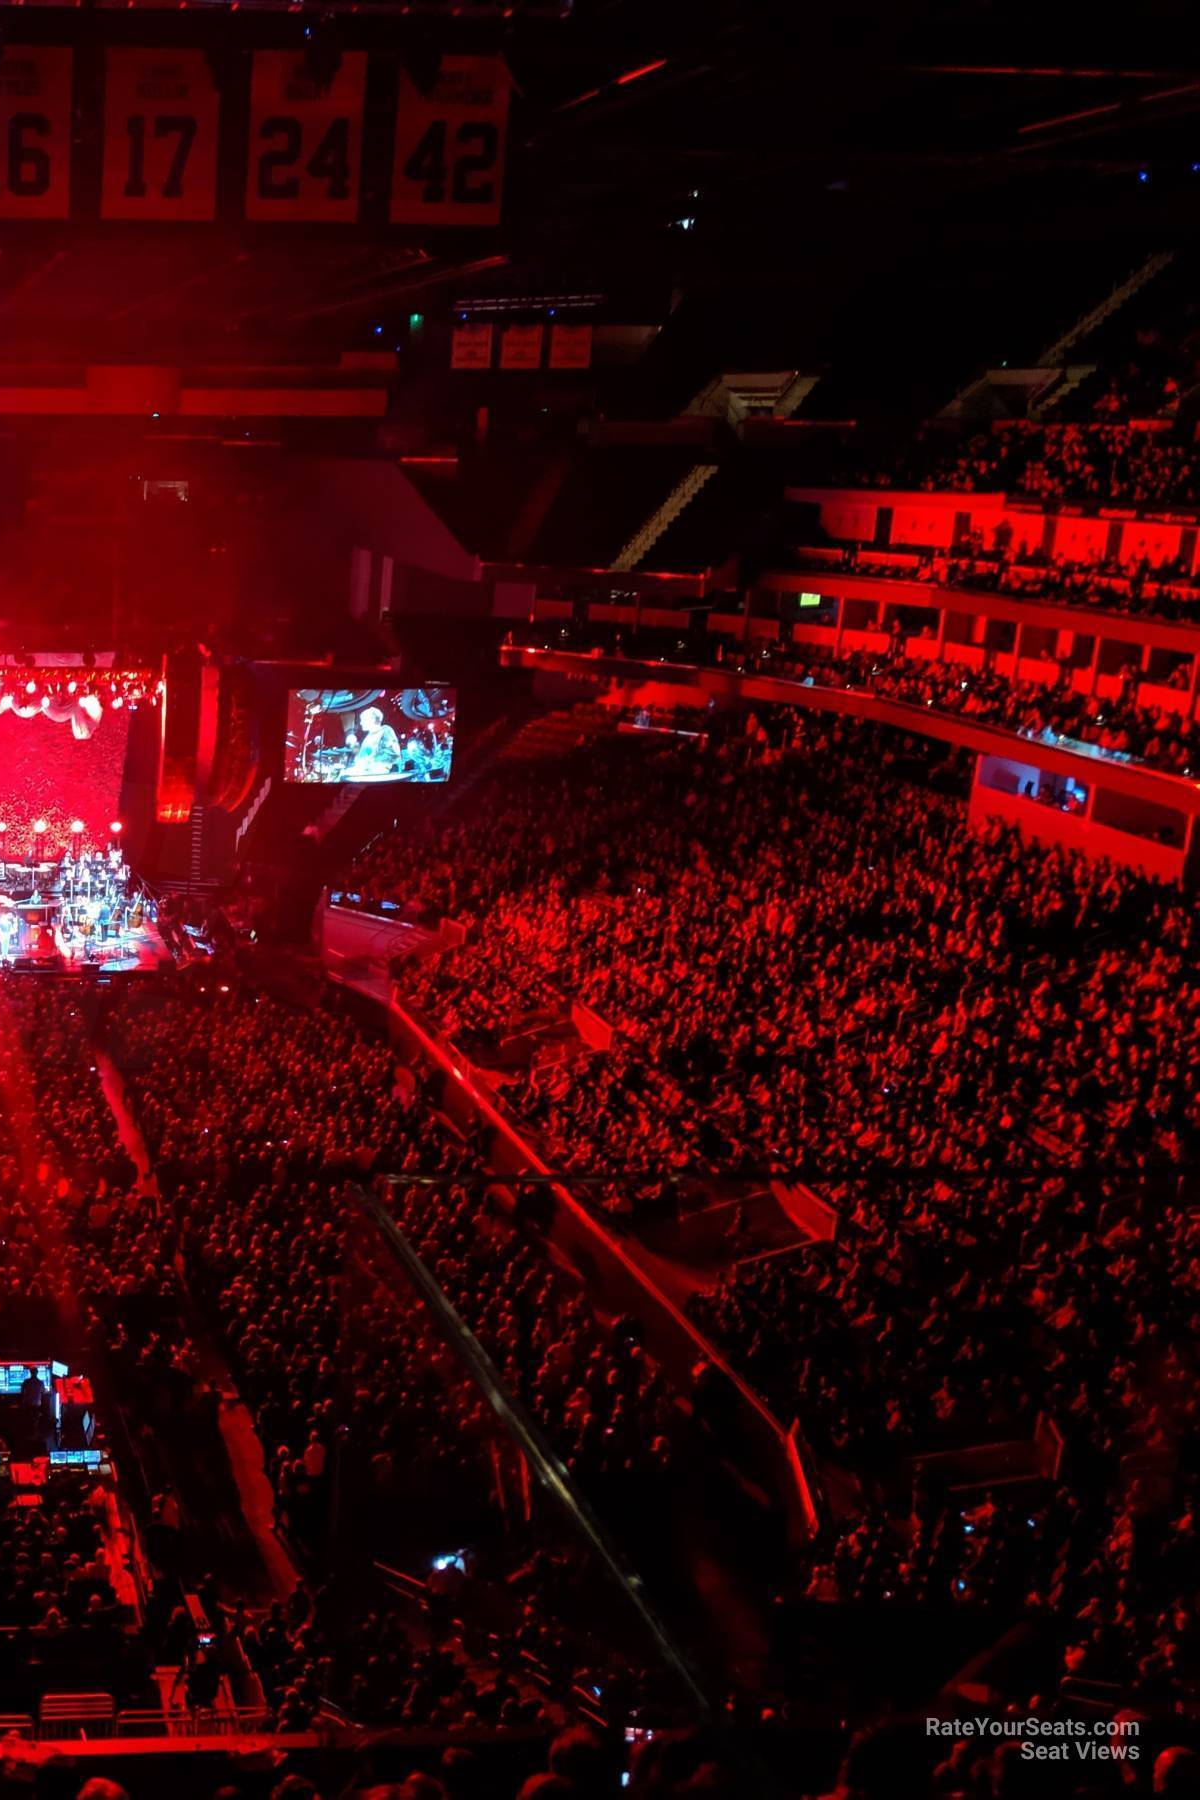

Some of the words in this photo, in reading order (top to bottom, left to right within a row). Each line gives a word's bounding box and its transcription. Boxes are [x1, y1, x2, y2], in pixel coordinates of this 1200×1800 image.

[124, 114, 198, 198] 17
[257, 116, 350, 200] 24
[403, 120, 498, 204] 42
